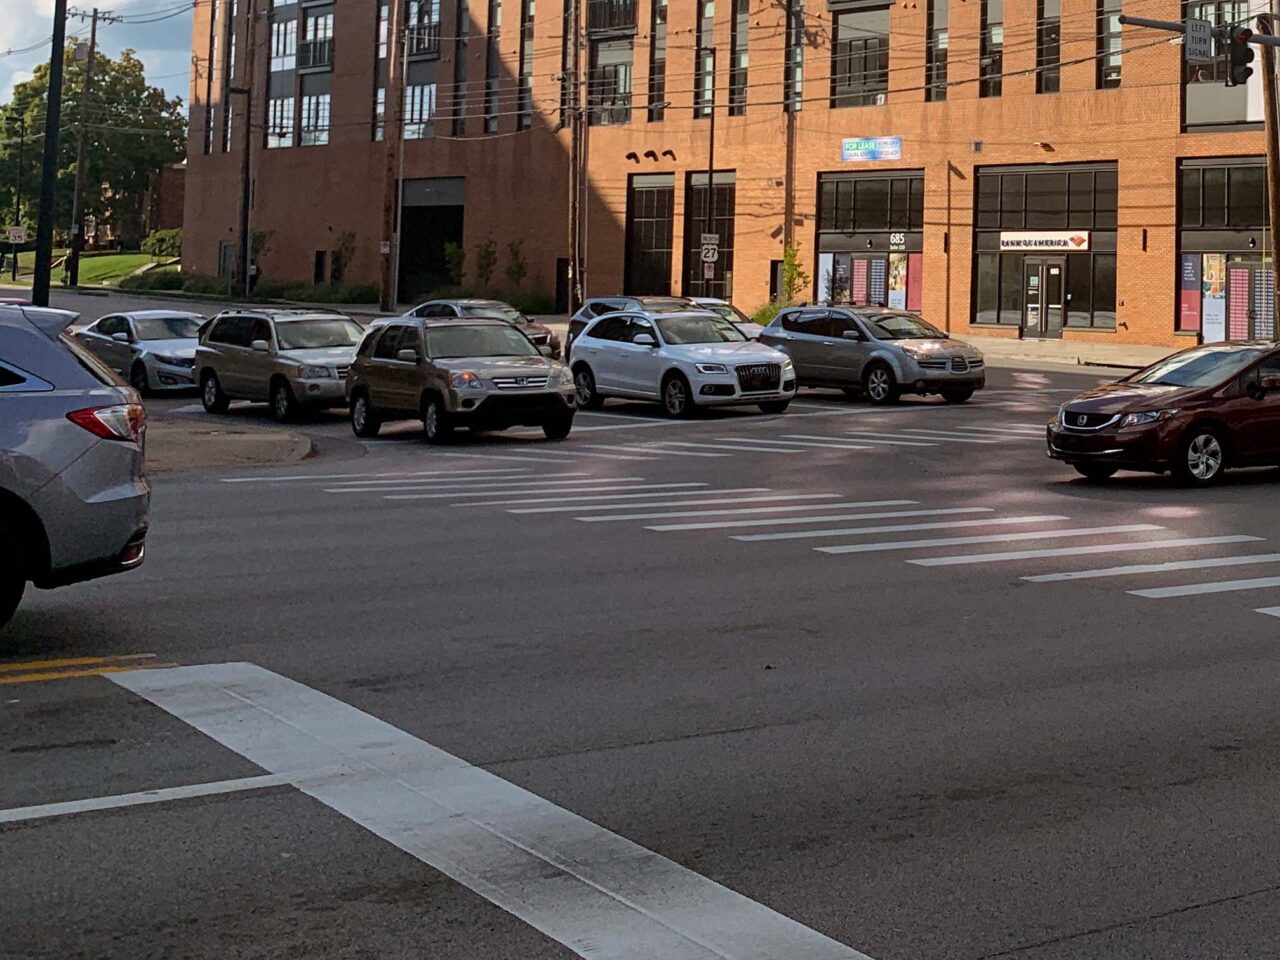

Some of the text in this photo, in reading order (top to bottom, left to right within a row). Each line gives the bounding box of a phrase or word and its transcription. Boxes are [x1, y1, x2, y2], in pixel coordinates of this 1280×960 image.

[1191, 23, 1206, 33] LEFT
[1191, 35, 1207, 45] TURN
[1188, 47, 1209, 59] SIGNAL
[845, 142, 858, 150] FOR
[858, 140, 876, 150] LEASE
[890, 233, 905, 244] 685
[1001, 239, 1022, 247] BANK
[1033, 239, 1069, 247] AMERICA
[703, 247, 716, 259] 27
